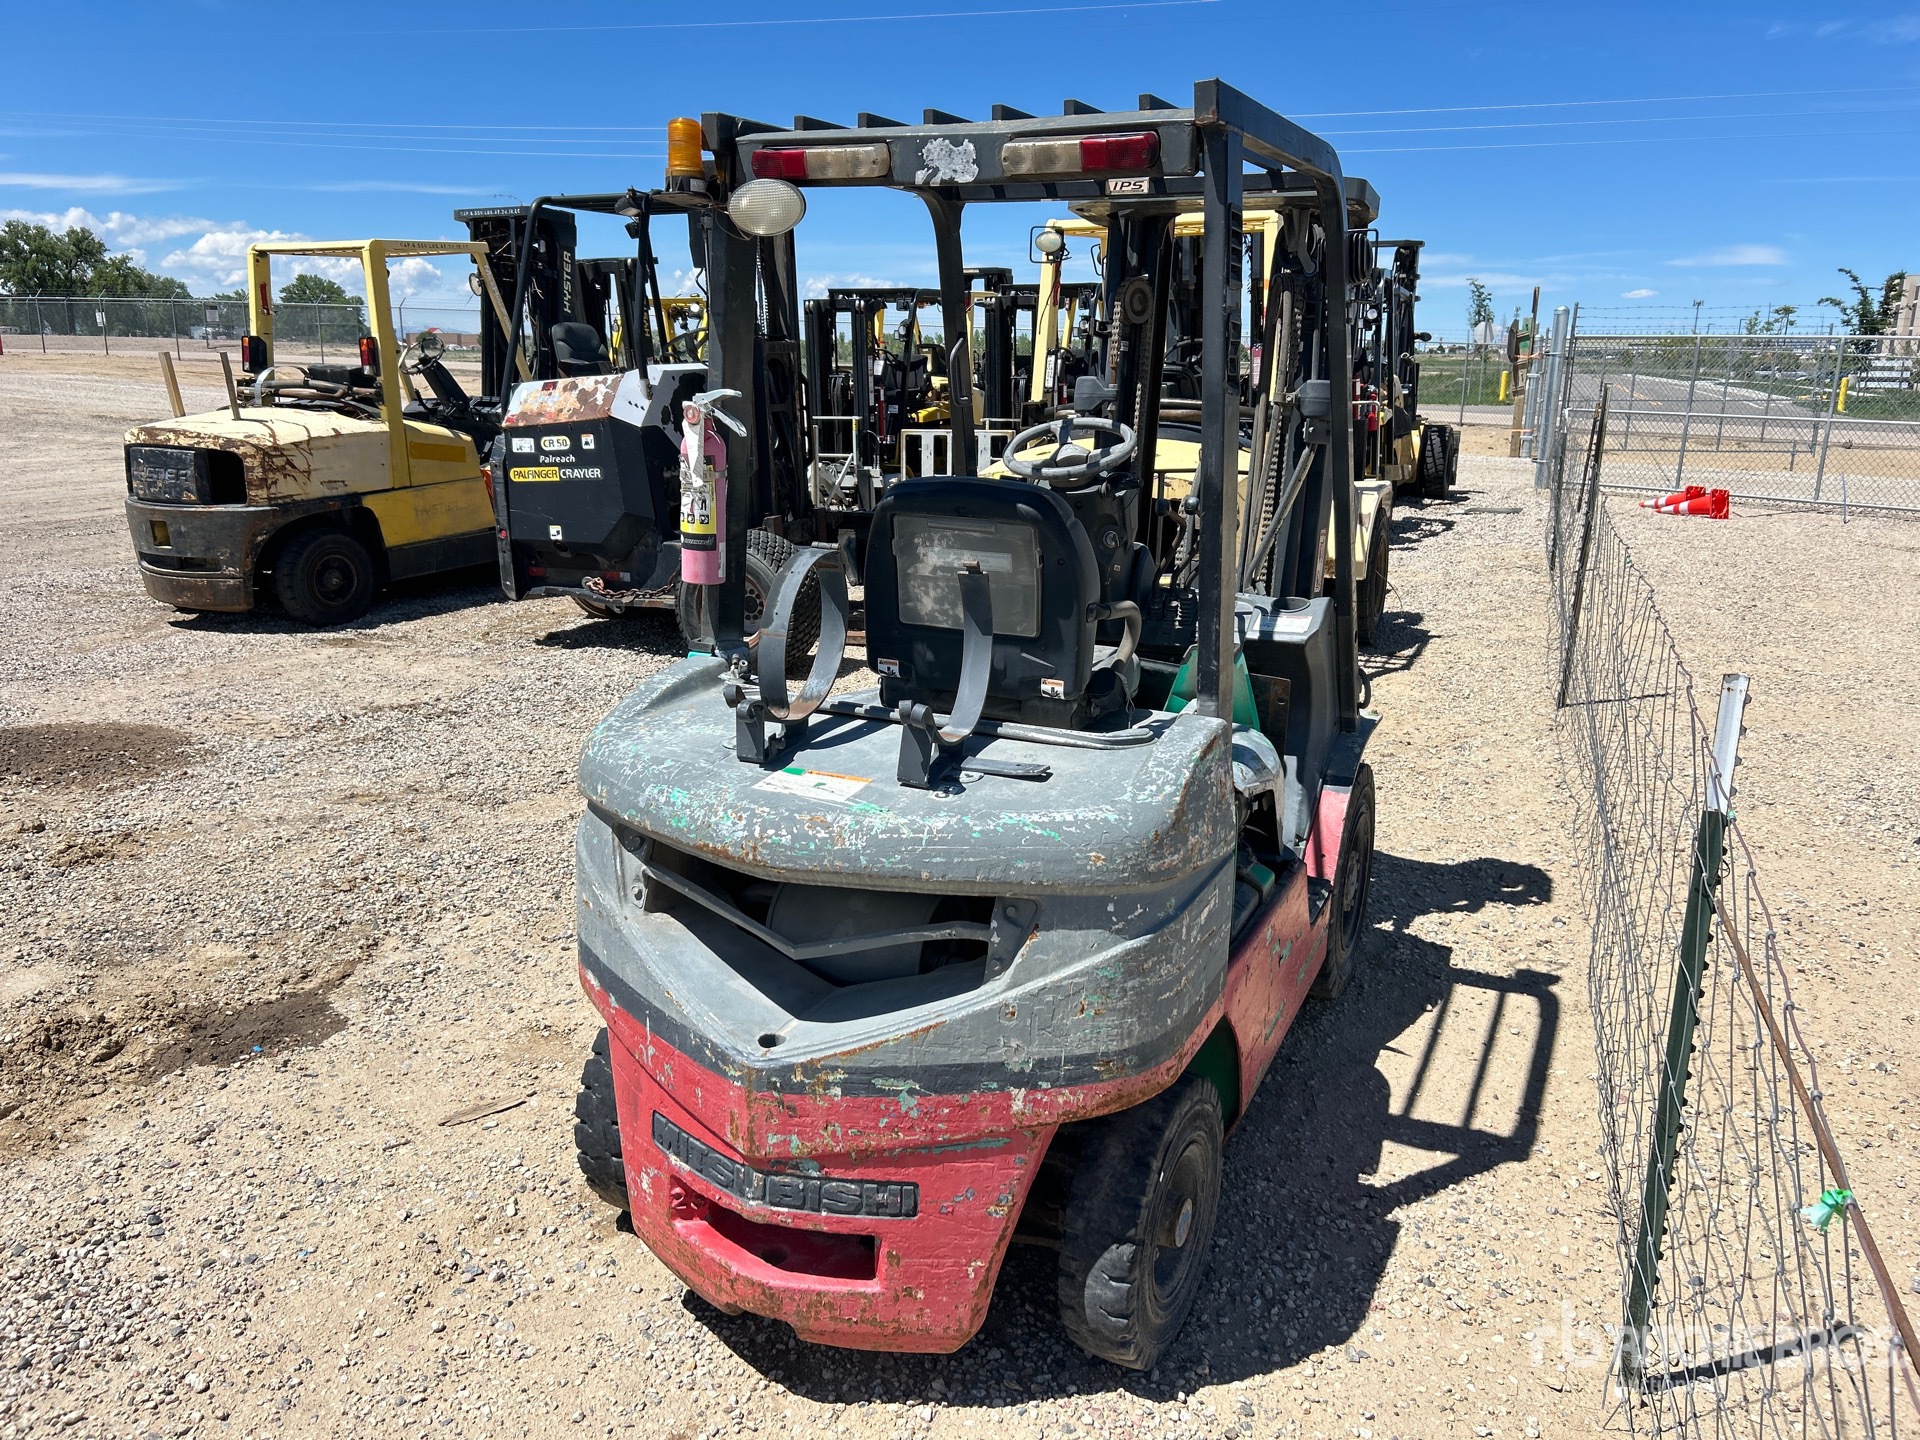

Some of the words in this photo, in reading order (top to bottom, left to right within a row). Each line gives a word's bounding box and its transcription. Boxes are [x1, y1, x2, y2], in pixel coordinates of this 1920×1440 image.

[1113, 181, 1145, 191] IPS
[563, 251, 571, 313] HYSTER
[543, 439, 555, 448] CR
[556, 438, 568, 448] 50
[539, 453, 576, 464] Palreach
[512, 469, 558, 480] PALFINGER
[560, 468, 602, 479] CRAYLER
[654, 1112, 918, 1218] MITSUBISHI
